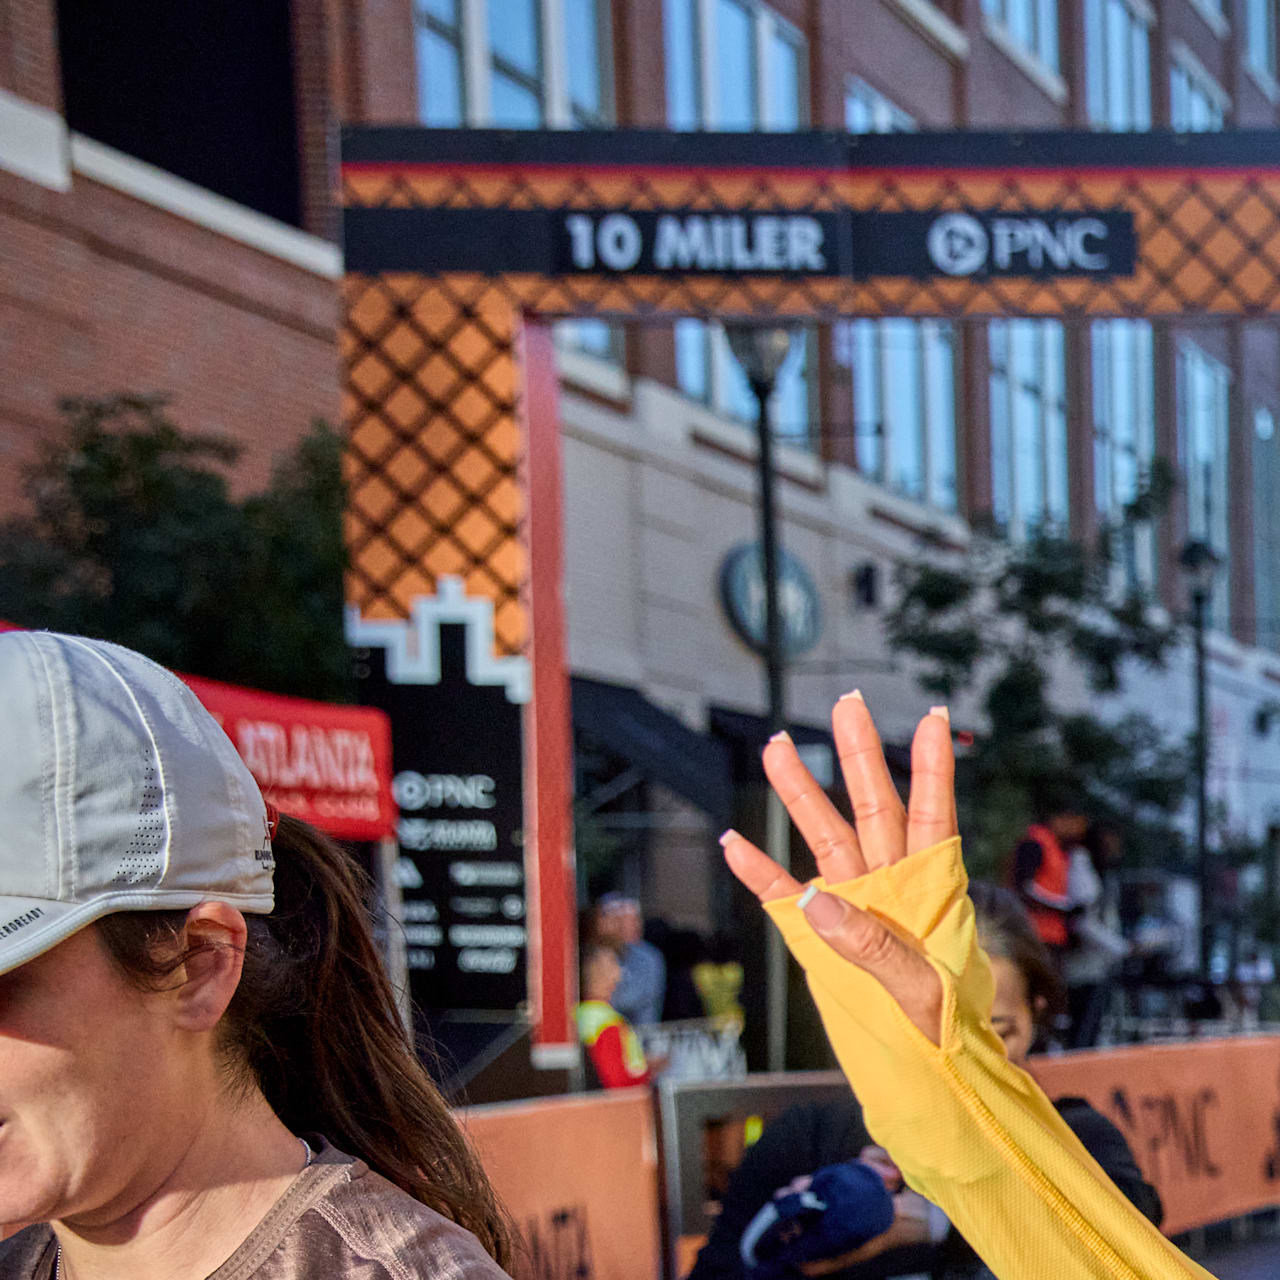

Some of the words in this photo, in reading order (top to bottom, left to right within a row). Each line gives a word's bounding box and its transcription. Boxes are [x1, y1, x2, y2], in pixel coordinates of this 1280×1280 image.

[567, 213, 644, 271] 10
[655, 213, 827, 271] MILER
[992, 217, 1109, 270] PNC
[426, 774, 496, 809] PNC
